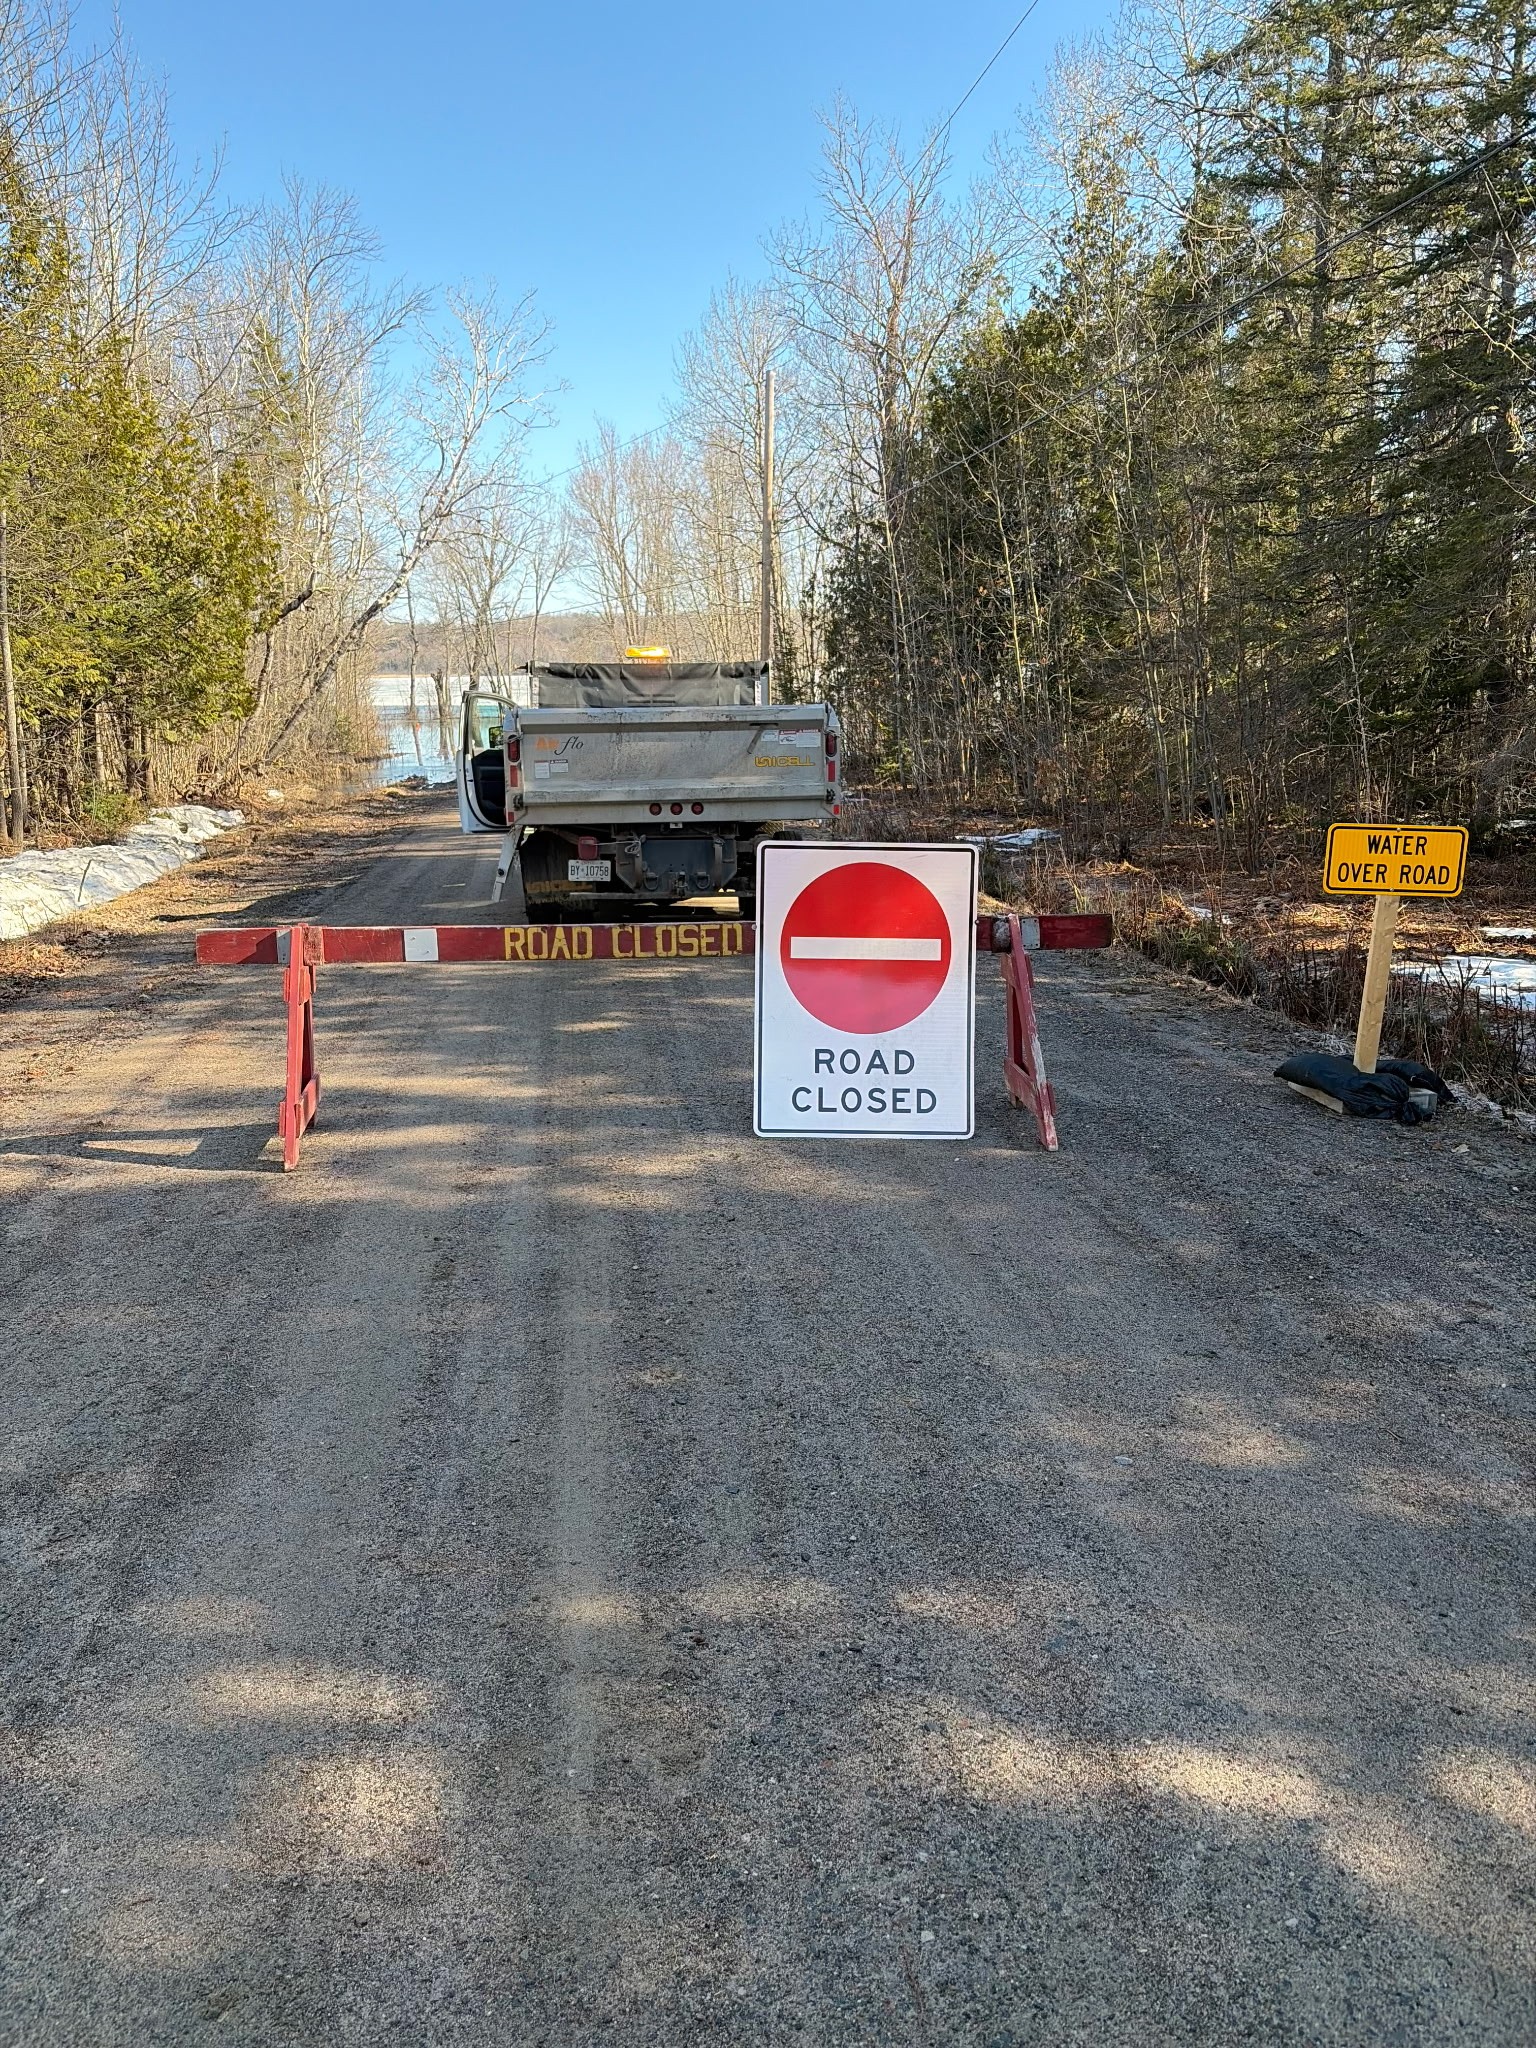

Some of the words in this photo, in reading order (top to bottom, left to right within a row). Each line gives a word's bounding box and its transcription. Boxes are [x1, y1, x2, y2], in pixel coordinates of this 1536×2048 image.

[1367, 834, 1428, 856] WATER
[570, 866, 580, 876] BY
[585, 866, 609, 877] 10758
[1337, 862, 1388, 884] OVER
[1399, 864, 1450, 885] ROAD
[504, 926, 593, 961] ROAD
[611, 923, 743, 959] CLOSED
[814, 1048, 915, 1075] ROAD
[791, 1086, 937, 1114] CLOSED
